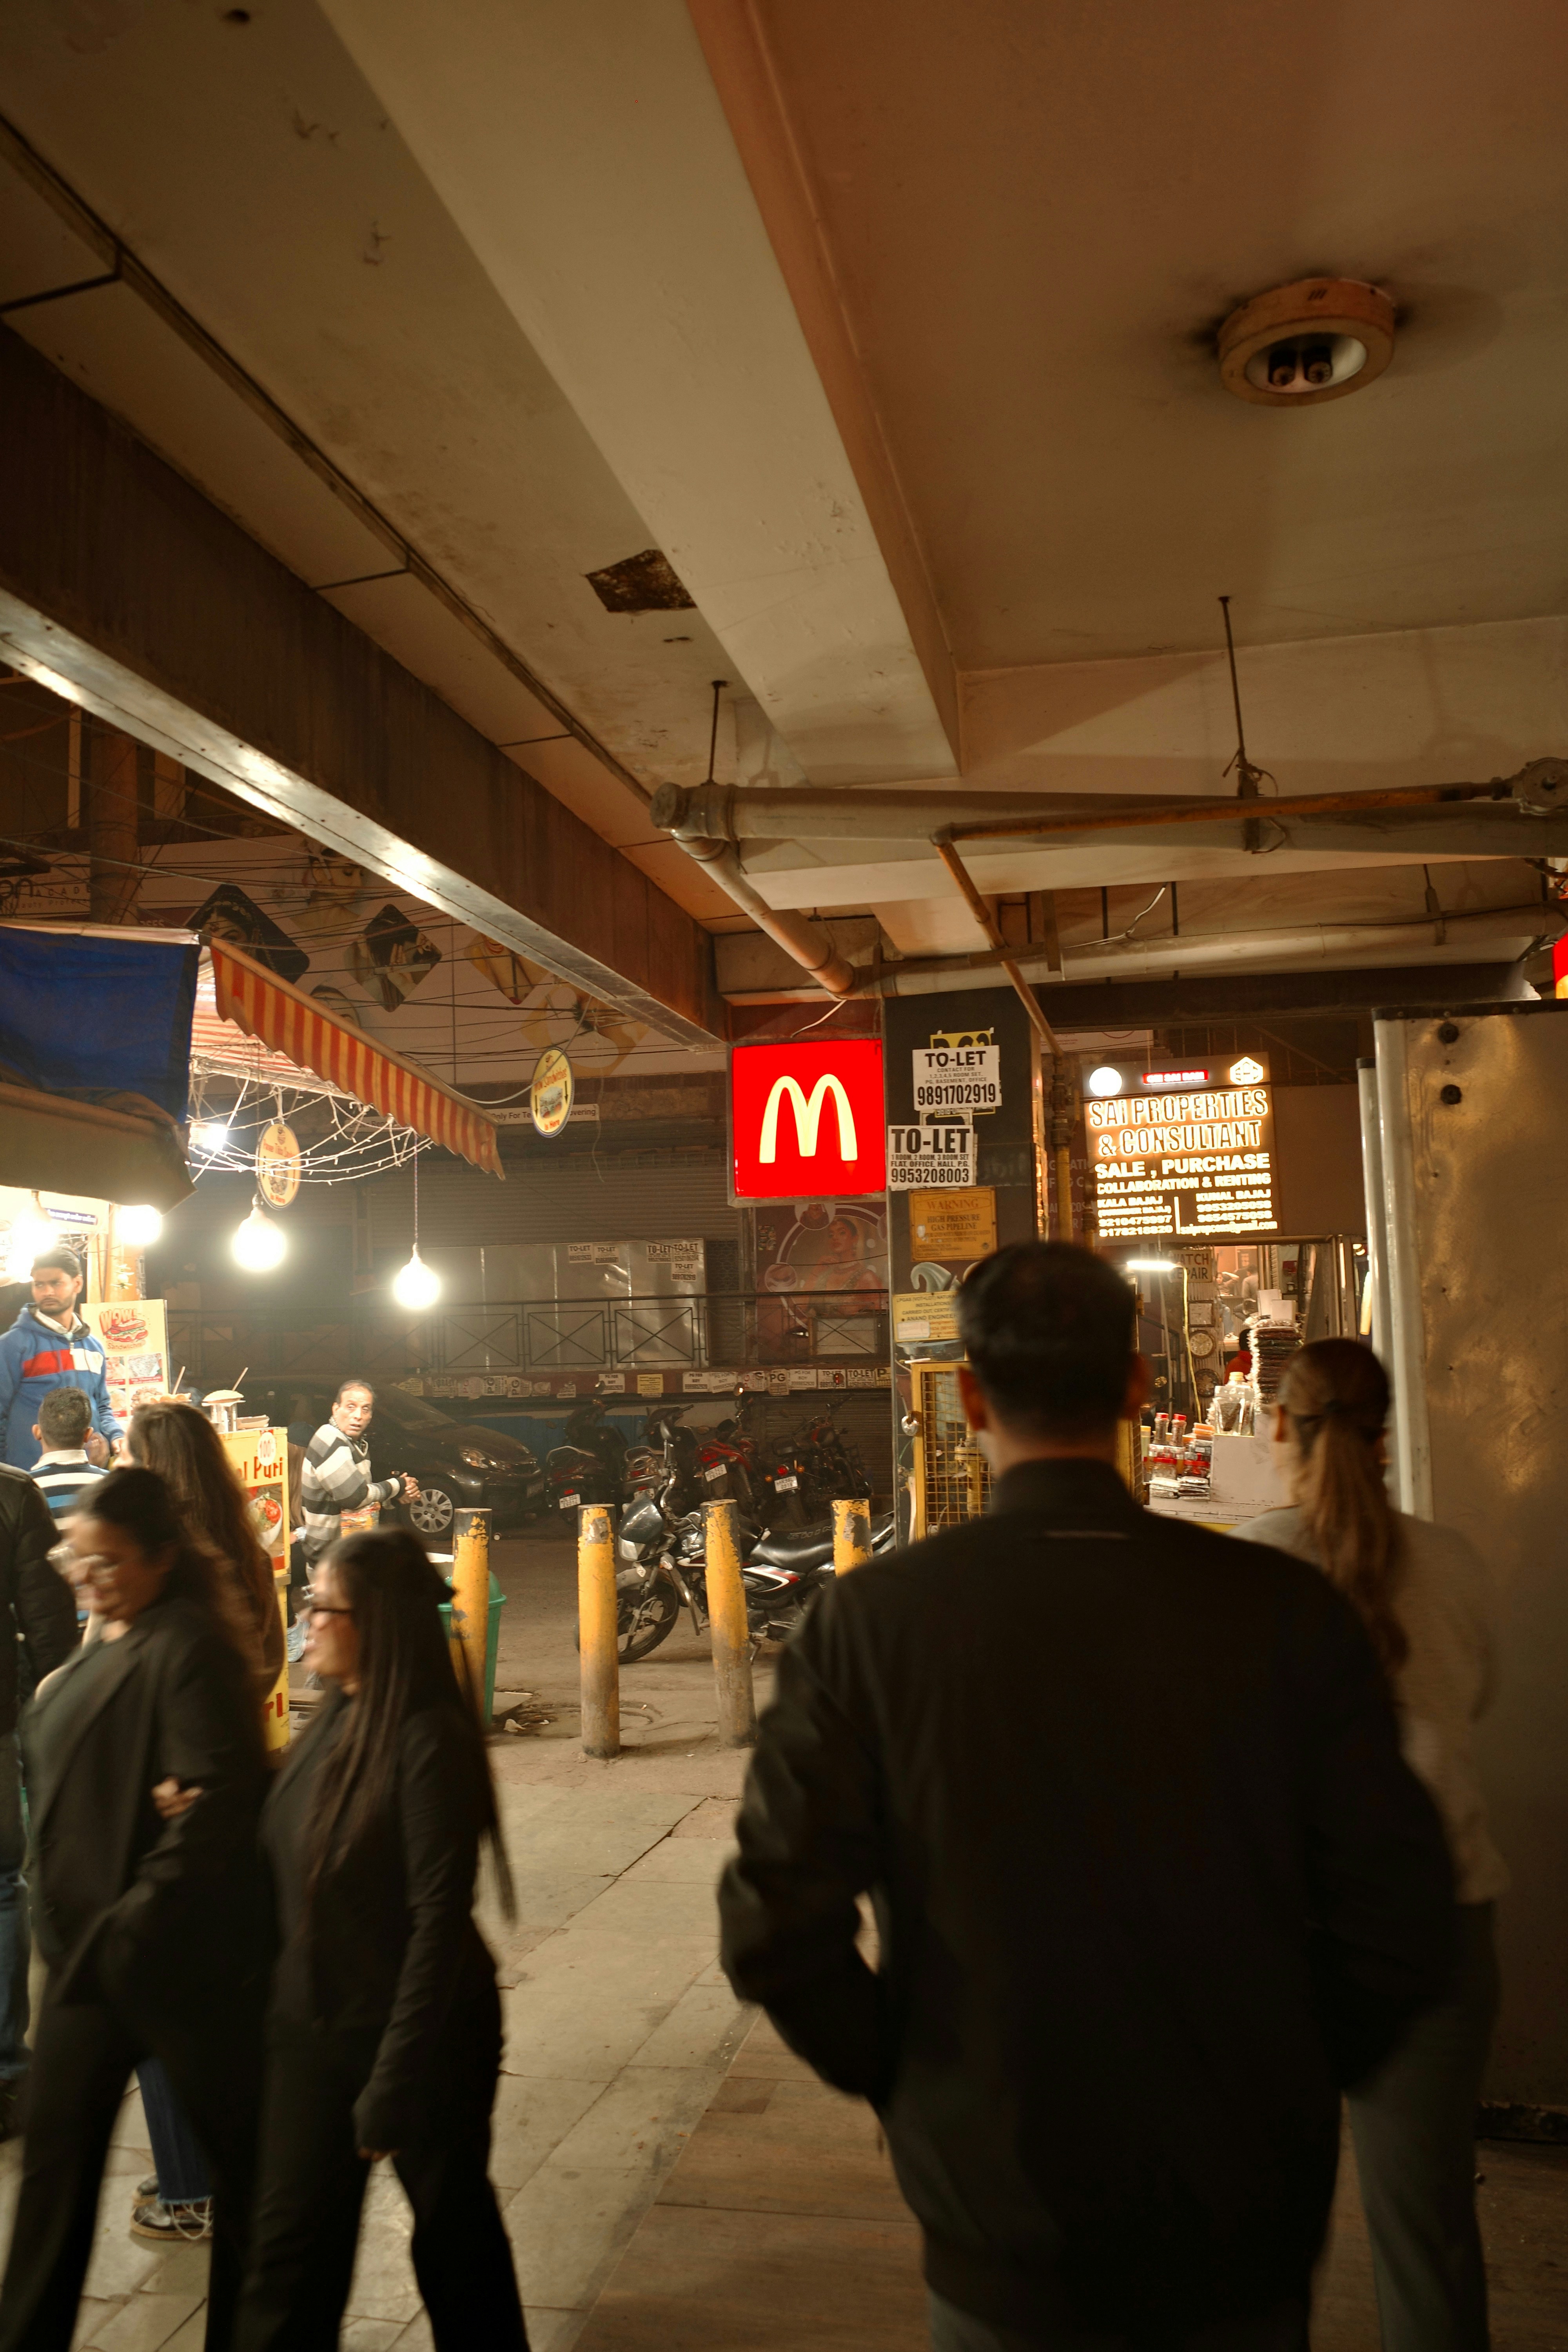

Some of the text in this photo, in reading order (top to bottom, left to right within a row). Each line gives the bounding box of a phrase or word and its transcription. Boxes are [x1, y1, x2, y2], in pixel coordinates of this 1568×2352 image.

[925, 1051, 986, 1067] TO-LET
[918, 1083, 996, 1105] 9891702919
[1089, 1089, 1269, 1128] SAI PROPERTIES
[891, 1128, 970, 1154] TO-LET
[1098, 1119, 1262, 1157] & CONSULTANT
[1094, 1161, 1146, 1179] SALE
[1161, 1153, 1271, 1175] PURCHASE
[891, 1168, 969, 1183] 9953208003
[1097, 1177, 1200, 1194] COLLABORATION
[1201, 1176, 1213, 1188] &
[1214, 1172, 1272, 1187] RENTING
[1097, 1197, 1127, 1208] KALA
[1128, 1195, 1163, 1206] BAJAJ
[1196, 1189, 1271, 1202] KUNAL BAJAJ
[927, 1199, 978, 1210] WARNING
[947, 1214, 980, 1223] PRESSURE
[673, 1243, 698, 1251] TO-LET
[770, 1373, 786, 1383] PG
[849, 1369, 875, 1377] TO-LET
